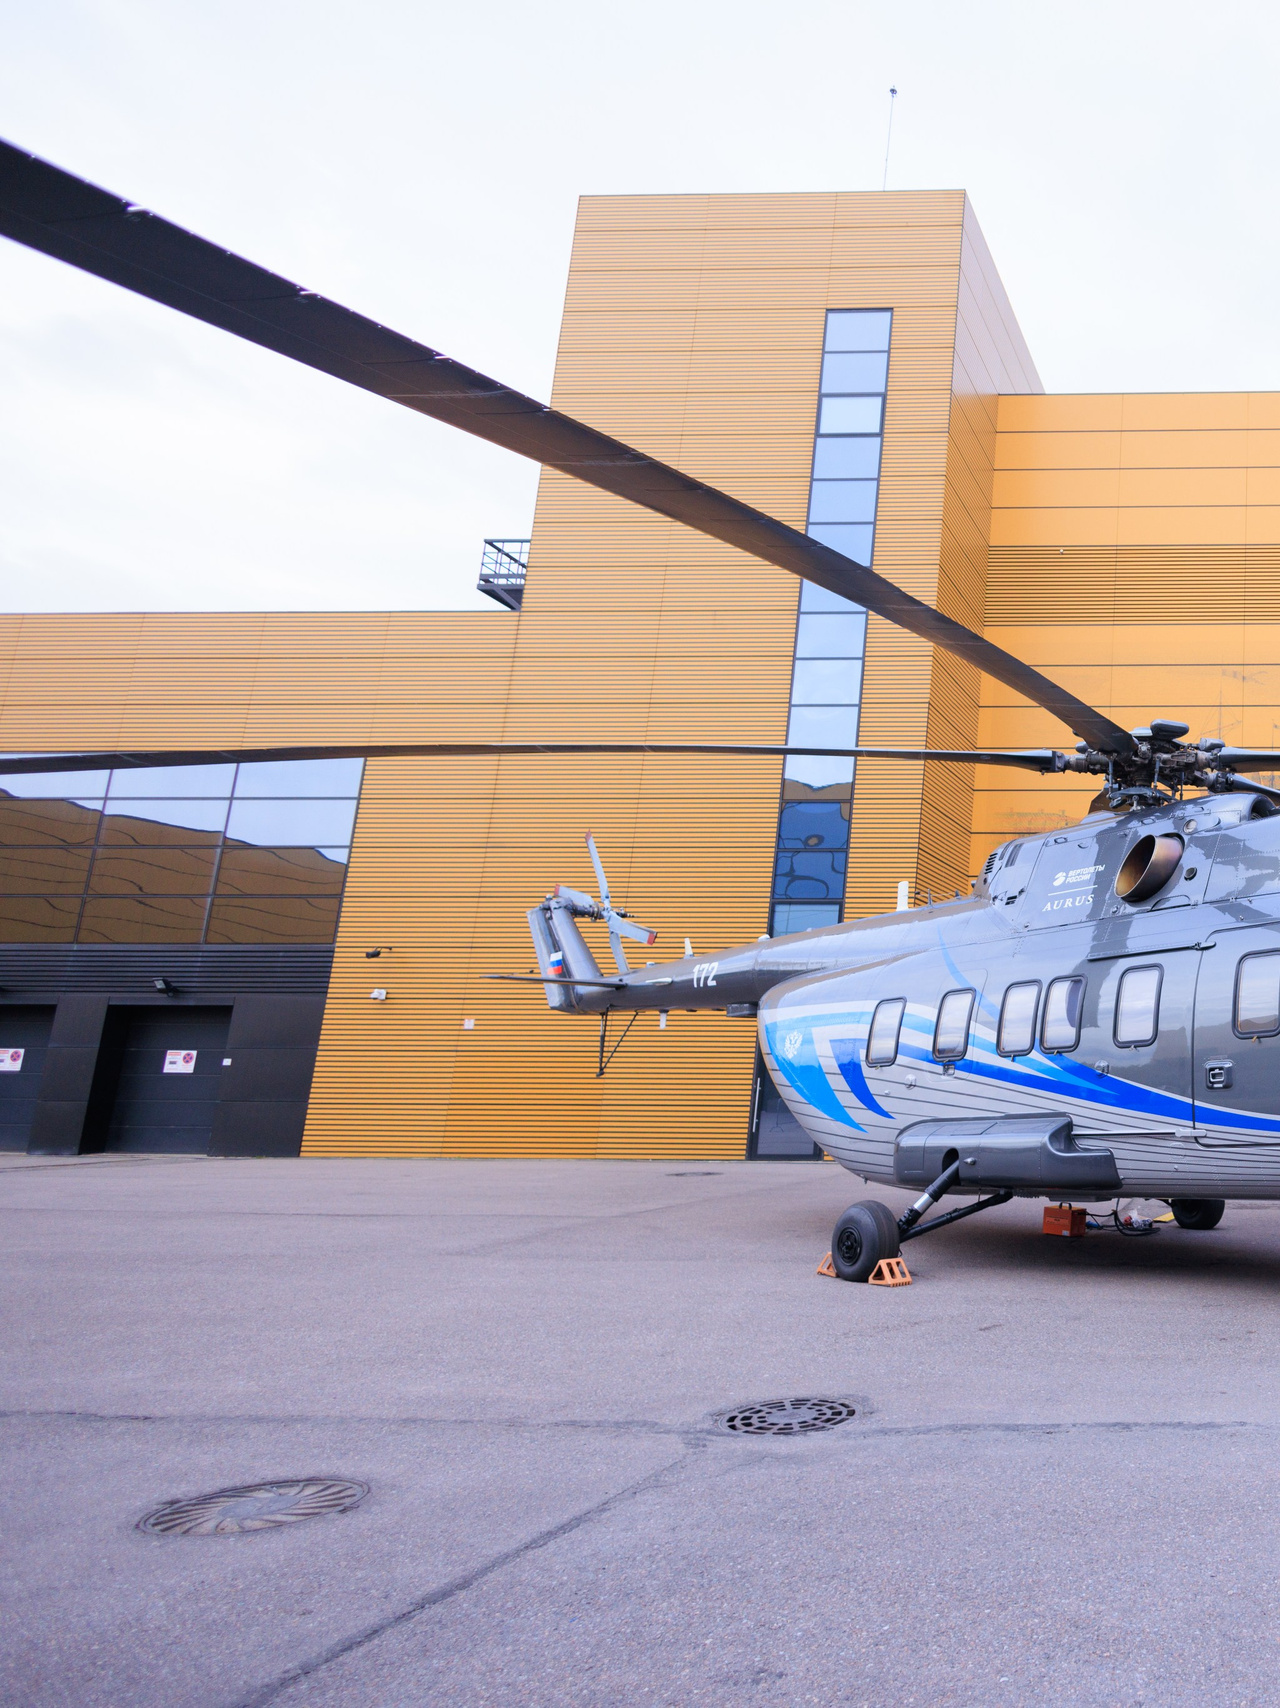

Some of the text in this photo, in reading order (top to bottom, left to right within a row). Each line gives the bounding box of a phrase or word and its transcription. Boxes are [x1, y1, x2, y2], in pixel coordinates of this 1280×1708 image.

[1068, 864, 1105, 876] ВЕРТОЛЕТЫ
[1066, 874, 1091, 883] РОССИИ
[1042, 894, 1094, 912] AURUS
[693, 962, 719, 988] 172
